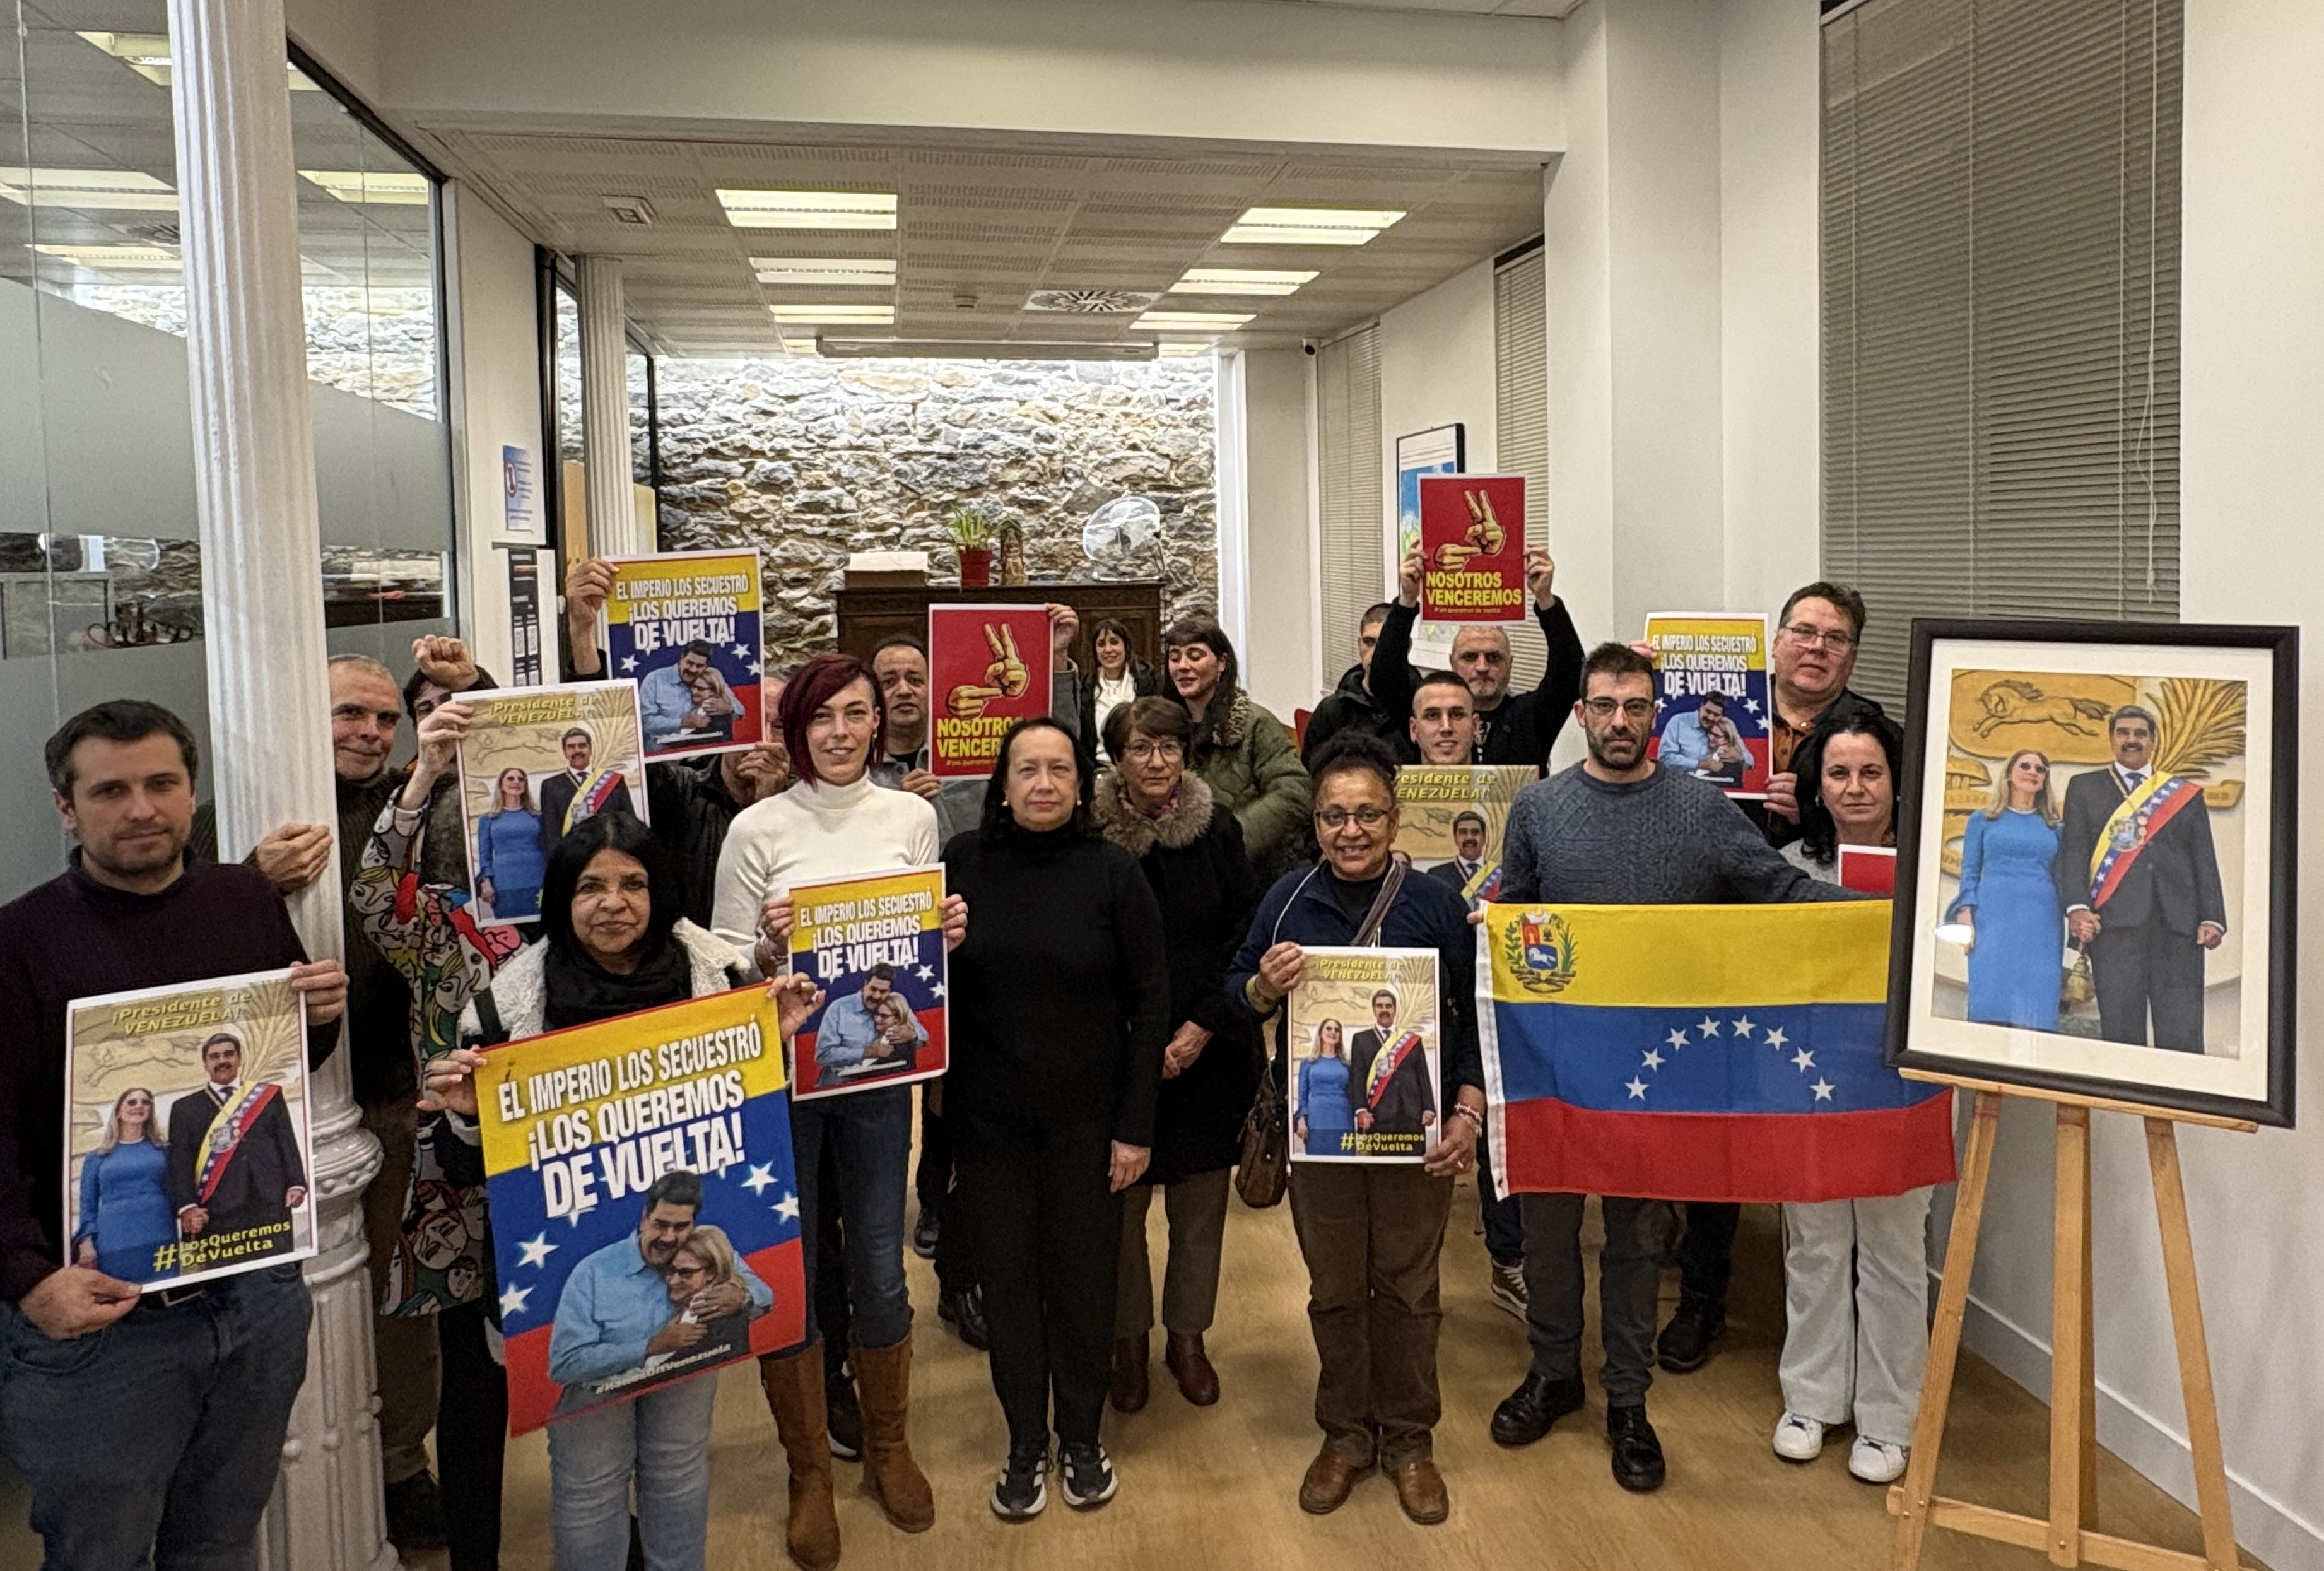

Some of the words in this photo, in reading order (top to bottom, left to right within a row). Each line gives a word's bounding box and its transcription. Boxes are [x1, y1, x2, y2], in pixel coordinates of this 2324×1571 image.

[616, 581, 628, 600] EL
[631, 579, 671, 599] IMPERIO
[674, 578, 693, 597] LOS
[694, 572, 748, 596] SECUESTRÓ
[1426, 571, 1503, 588] NOSOTROS
[1426, 588, 1522, 606] VENCEREMOS
[629, 601, 660, 626] ¡LOS
[663, 596, 738, 620] QUEREMOS
[635, 621, 660, 652] DE
[662, 617, 736, 647] VUELTA!
[1652, 637, 1660, 650] EL
[1662, 635, 1693, 651] IMPERIO
[1695, 635, 1710, 651] LOS
[1660, 654, 1684, 673] ¡LOS
[1686, 654, 1747, 671] QUEREMOS
[1664, 672, 1685, 695] DE
[1687, 673, 1746, 697] VUELTA!
[580, 695, 599, 705] de
[1476, 773, 1497, 784] de
[1394, 787, 1489, 800] ENEZUELA!
[800, 907, 813, 927] EL
[814, 901, 855, 925] IMPERIO
[859, 898, 876, 919] LOS
[879, 887, 932, 916] SECUESTRÓ
[813, 926, 843, 953] ¡LOS
[847, 915, 921, 945] QUEREMOS
[819, 948, 845, 979] DE
[847, 937, 919, 973] VUELTA!
[228, 992, 251, 1004] de
[125, 1007, 242, 1034] VENEZUELA!
[498, 1081, 525, 1122] EL
[529, 1059, 612, 1114] IMPERIO
[616, 1049, 652, 1088] LOS
[657, 1014, 762, 1081] SECUESTRÓ
[528, 1109, 592, 1171] ¡LOS
[597, 1070, 745, 1144] QUEREMOS
[543, 1152, 599, 1219] DE
[601, 1112, 745, 1201] VUELTA!
[180, 1239, 274, 1267] DeVuelta
